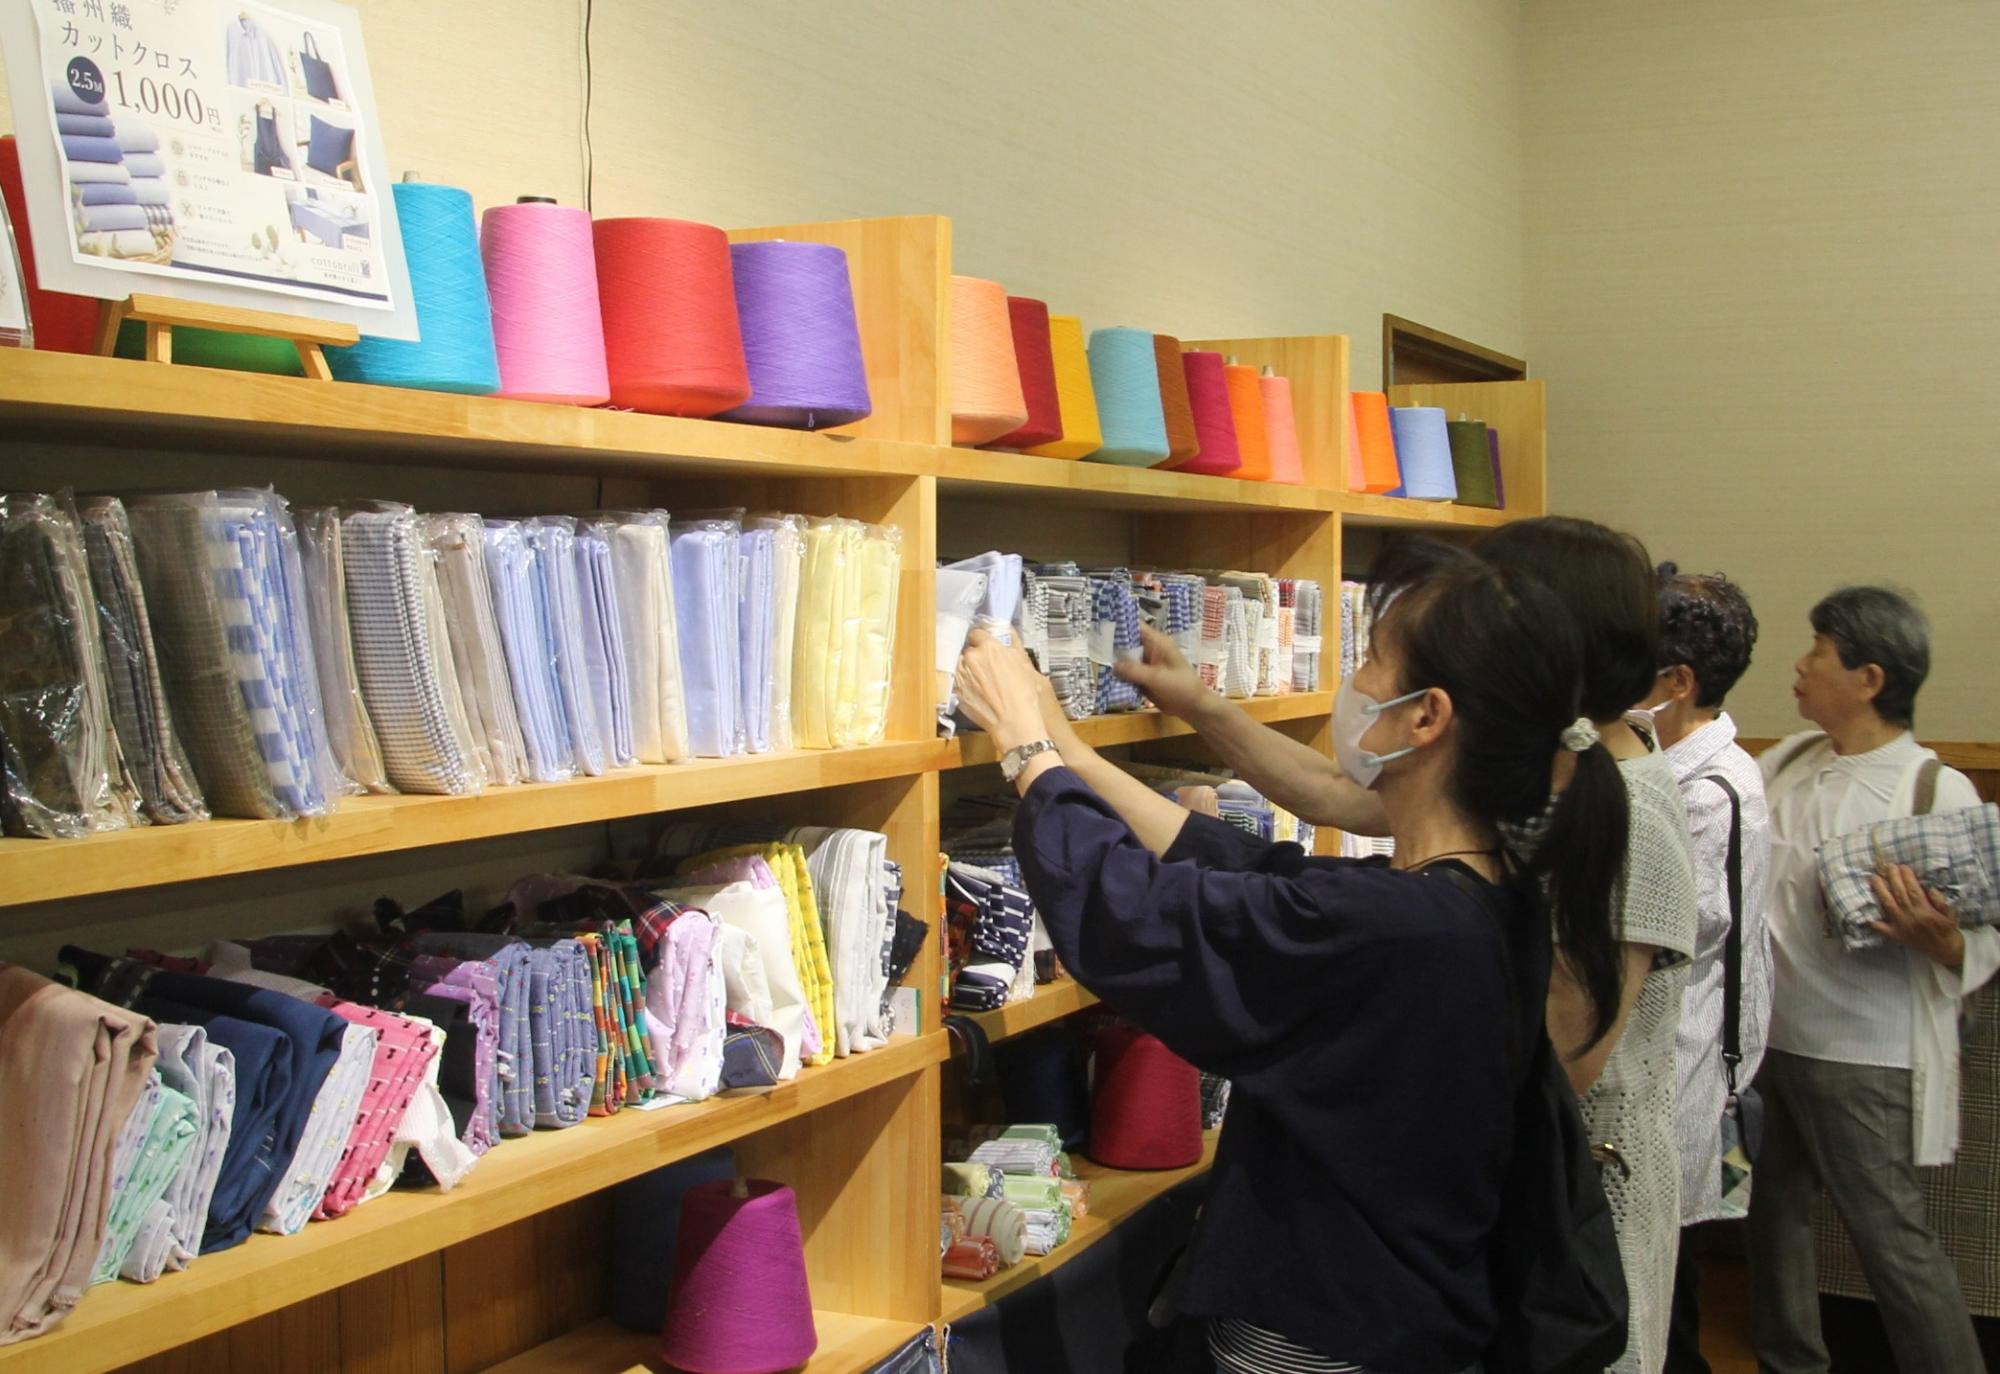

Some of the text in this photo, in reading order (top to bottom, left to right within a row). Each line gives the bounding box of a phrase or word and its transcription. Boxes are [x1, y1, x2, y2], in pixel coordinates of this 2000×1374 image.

[62, 20, 198, 80] カットクロス
